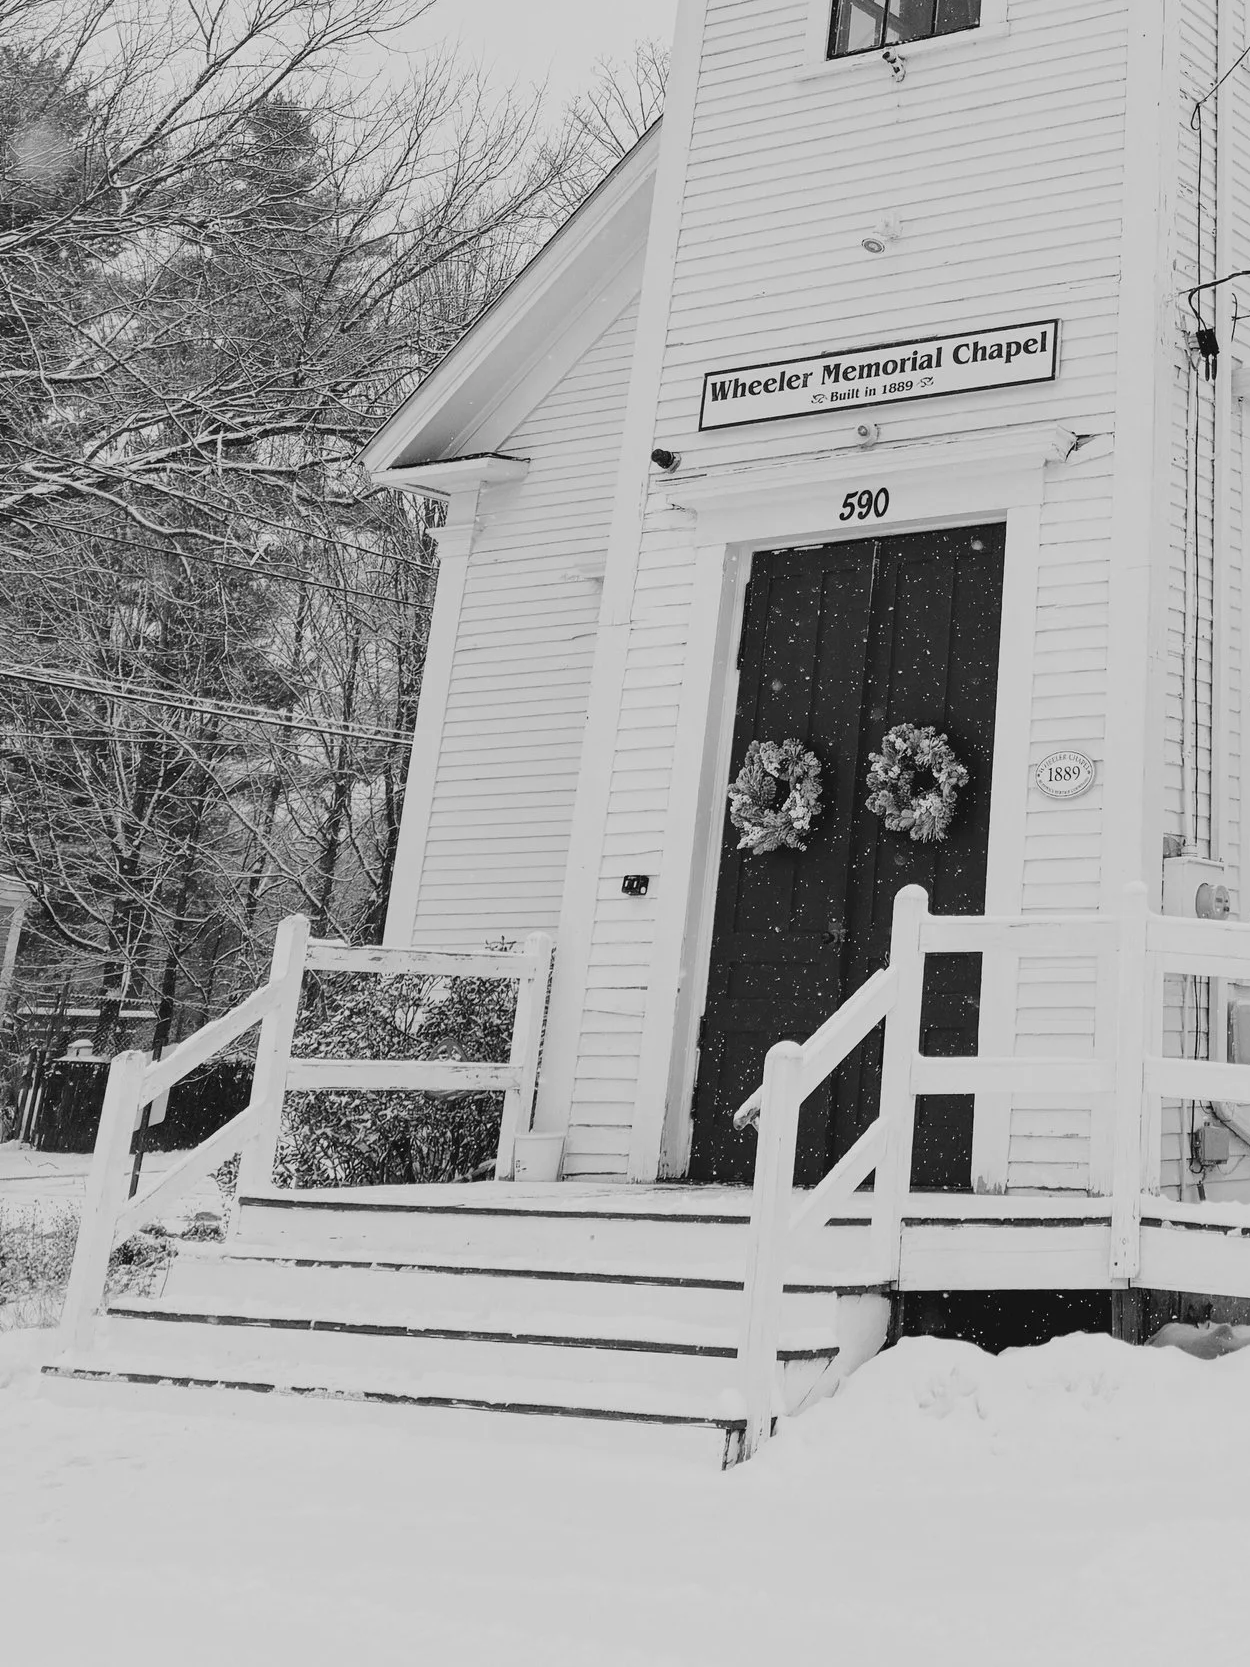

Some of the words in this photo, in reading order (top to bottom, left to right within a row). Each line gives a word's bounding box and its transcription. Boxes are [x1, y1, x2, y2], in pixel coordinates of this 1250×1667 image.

[710, 371, 813, 402] Wheeler
[821, 346, 943, 385] Memorial
[952, 331, 1048, 365] Chapel
[830, 388, 861, 403] Built
[864, 386, 877, 397] in
[881, 380, 914, 395] 1889
[839, 487, 890, 521] 590
[1048, 766, 1081, 782] 1889
